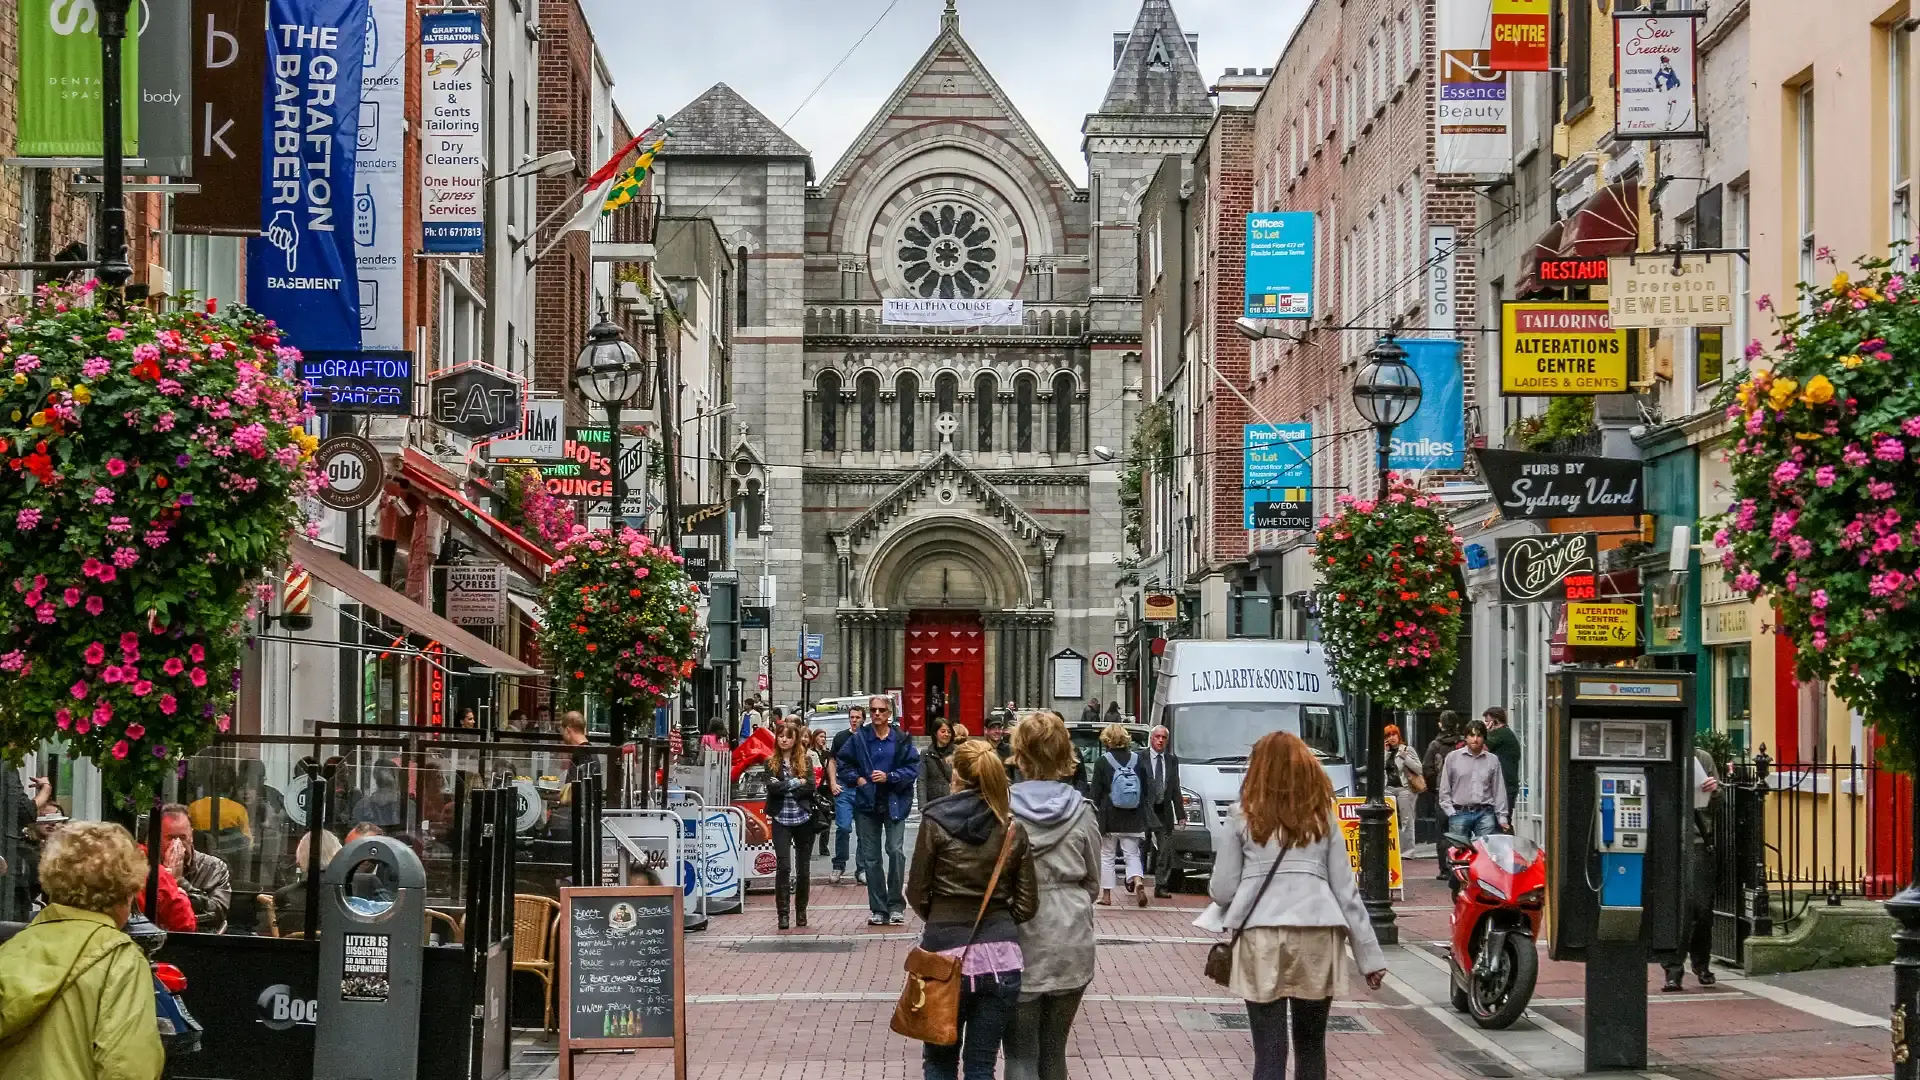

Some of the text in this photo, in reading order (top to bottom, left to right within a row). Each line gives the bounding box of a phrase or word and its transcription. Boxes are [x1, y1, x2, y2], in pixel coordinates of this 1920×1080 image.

[1495, 23, 1546, 42] CENTRE
[1636, 18, 1675, 40] Sew
[279, 24, 339, 51] THE
[424, 34, 480, 42] ALTERATIONS
[1625, 38, 1681, 56] Creative
[49, 77, 101, 85] DENTA
[432, 80, 473, 92] Ladies
[61, 91, 101, 99] SPAS
[143, 88, 182, 106] body
[447, 93, 457, 104] &
[1441, 84, 1506, 99] Essence
[434, 106, 471, 118] Gents
[1439, 104, 1504, 121] Beauty
[271, 54, 302, 206] BARBER
[424, 119, 480, 133] Tailoring
[306, 55, 338, 233] GRAFTON
[440, 140, 464, 155] Dry
[425, 153, 480, 166] Cleaners
[424, 175, 482, 188] One Hour
[428, 188, 476, 204] Xpress
[428, 204, 477, 216] Services
[1251, 218, 1285, 228] Offices
[424, 226, 482, 238] Ph: 01 6717813
[1251, 229, 1281, 240] To Let
[1540, 260, 1608, 281] RESTAUR
[1636, 262, 1705, 275] Loran
[267, 276, 341, 291] BASEMENT
[1626, 279, 1716, 294] Brereton
[888, 301, 992, 311] THE ALPHA COURSE
[1611, 294, 1731, 315] JEWELLER
[1522, 313, 1609, 330] TAILORING
[1514, 338, 1620, 354] ALTERATIONS
[323, 359, 408, 378] GRAFTON
[1536, 358, 1597, 373] CENTRE
[1514, 377, 1619, 388] LADIES & GENTS
[436, 382, 514, 427] EAT
[576, 429, 611, 443] WINE
[1249, 427, 1306, 440] Prime Retail
[320, 441, 349, 461] gourmet
[351, 442, 373, 462] burger
[1388, 437, 1454, 457] Smiles
[564, 439, 612, 476] HOES
[618, 443, 642, 481] YLIST
[1249, 452, 1279, 462] To Let
[328, 460, 362, 483] gbk
[1521, 462, 1586, 476] FURS BY
[546, 478, 613, 497] OUNGE
[330, 492, 361, 503] kitchen
[1503, 476, 1638, 515] Sydney Vard
[1268, 502, 1299, 510] AVEDA
[1257, 517, 1310, 527] WHETSTONE
[1501, 535, 1594, 599] Cave
[451, 580, 497, 592] XPRESS
[1563, 575, 1595, 586] WINE
[1566, 586, 1596, 599] BAR
[1575, 607, 1629, 615] ALTERATION
[461, 616, 496, 625] 6717813
[1585, 615, 1620, 623] CENTRE
[1097, 657, 1109, 668] 50
[1297, 671, 1320, 693] LTD
[345, 935, 389, 947] LITTER IS
[345, 946, 388, 956] DISGUSTING
[345, 957, 388, 966] SO ARE THOSE
[345, 964, 388, 973] RESPONSIBLE
[273, 992, 318, 1021] Boc
[576, 1003, 604, 1013] LUNCH
